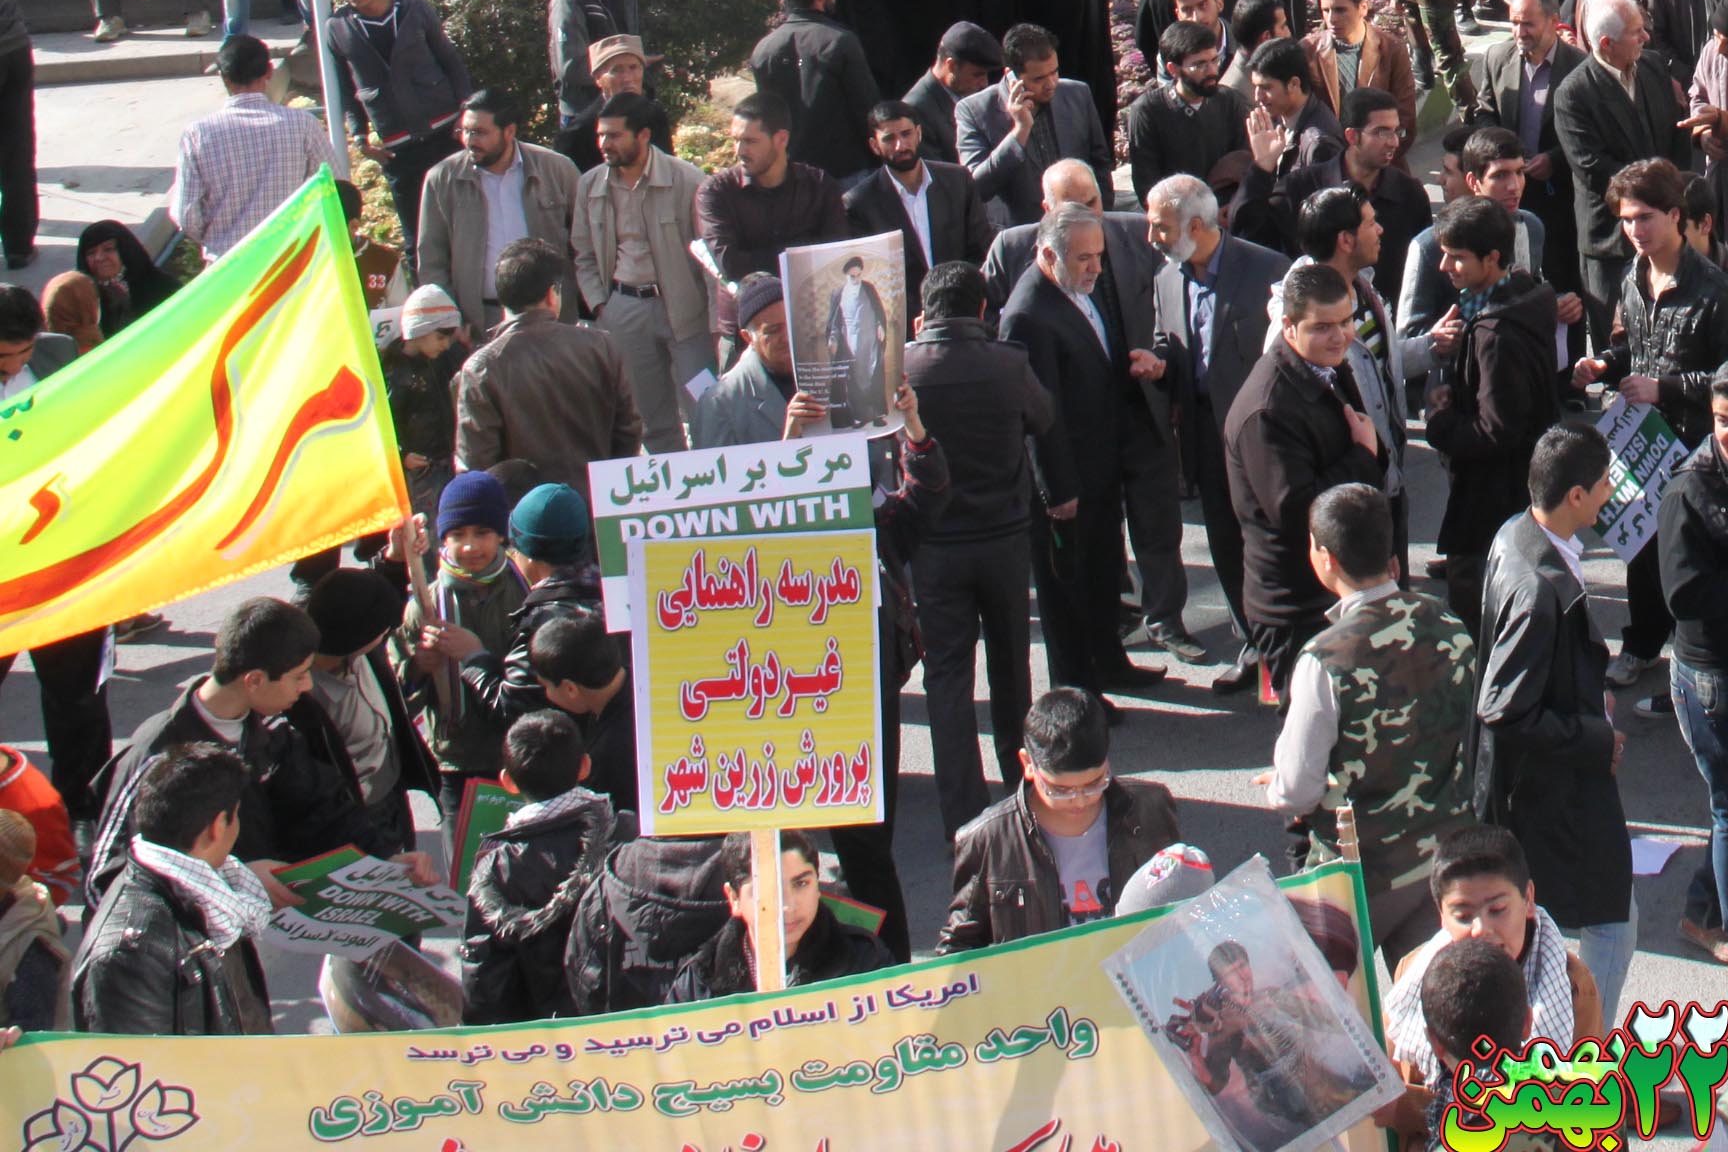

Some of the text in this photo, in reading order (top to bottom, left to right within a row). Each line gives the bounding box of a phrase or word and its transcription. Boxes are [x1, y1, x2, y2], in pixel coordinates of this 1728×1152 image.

[368, 273, 387, 289] 33
[609, 445, 853, 507] مرگ بر اسرائیل
[619, 492, 851, 541] DOWN WITH
[656, 545, 862, 631] مدرسه راهنمایی
[657, 726, 873, 815] پرورش زرین شهر
[313, 905, 383, 926] ISRAEL
[316, 884, 435, 924] DOWN WITH
[336, 932, 383, 948] الموت
[406, 971, 981, 1067] امریکا از اسلام می ترسید و می ترسد
[308, 1006, 1102, 1144] واحد مقاومت بسیج دانش آموزی
